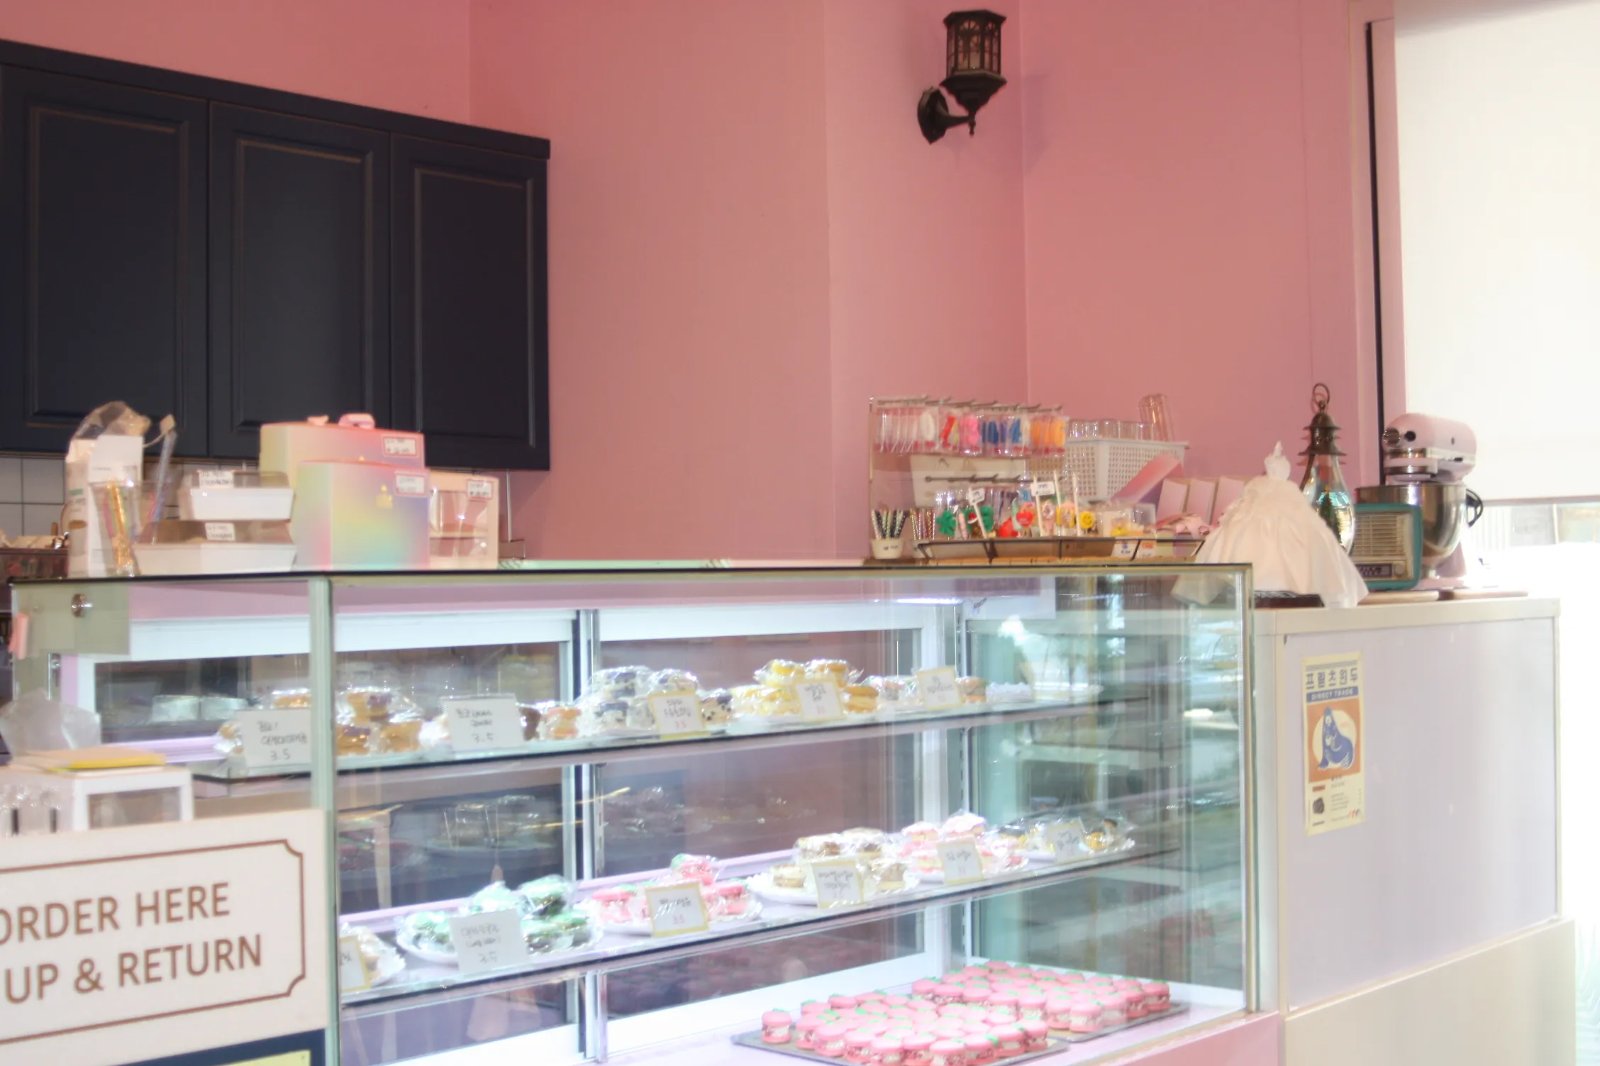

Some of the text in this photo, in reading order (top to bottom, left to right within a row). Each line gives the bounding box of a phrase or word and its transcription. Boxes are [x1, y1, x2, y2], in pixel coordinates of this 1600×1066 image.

[135, 881, 230, 928] HERE
[4, 933, 262, 1004] UP & RETURN
